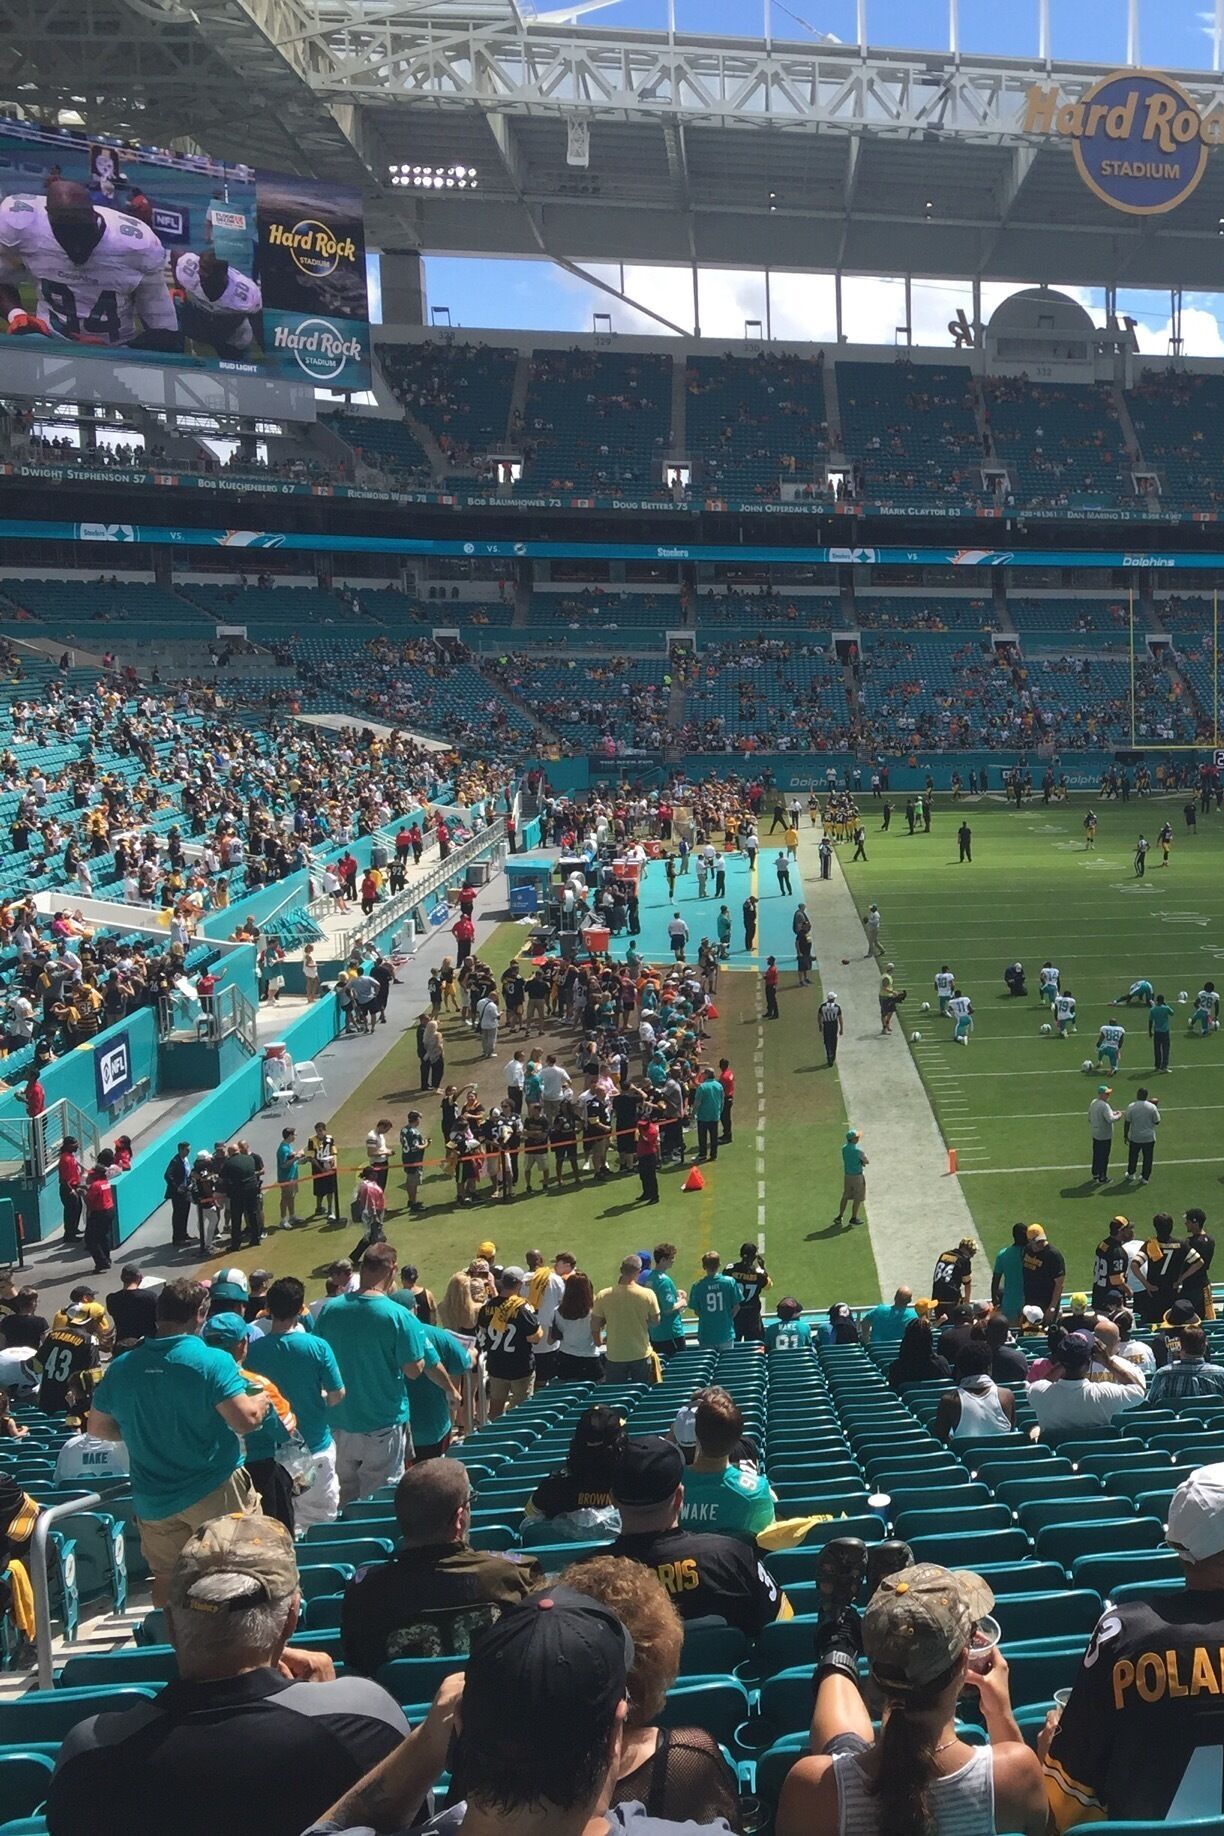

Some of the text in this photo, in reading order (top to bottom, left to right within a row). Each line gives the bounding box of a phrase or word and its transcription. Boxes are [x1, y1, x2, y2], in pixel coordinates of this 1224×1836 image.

[1023, 83, 1139, 139] Hard
[1102, 160, 1180, 179] STADIUM
[157, 215, 178, 228] NFL
[269, 224, 355, 261] Hard Rock
[300, 257, 330, 267] STADIUM
[274, 327, 361, 360] Hard Rock
[219, 361, 257, 372] BUD LIGHT
[305, 356, 336, 367] STADIUM
[21, 466, 146, 484] DWIGHT STEPHENSON 57
[198, 478, 295, 494] BOB KUECHENBERG 67
[467, 497, 561, 507] BOB BAUMHOWER 73
[613, 500, 638, 510] DOUG
[641, 501, 673, 511] BETTERS
[739, 504, 823, 514] JOHN OFFERDAHL 56
[880, 507, 960, 516] MARK CLAYTON 83
[1067, 510, 1085, 519] DAN
[1087, 511, 1118, 520] MARINO
[1120, 511, 1130, 520] 13
[1123, 556, 1175, 567] Dolphins
[956, 1001, 965, 1012] 11
[1058, 1000, 1069, 1012] 19
[1200, 996, 1213, 1008] 26
[1105, 1029, 1119, 1041] 88
[111, 1056, 125, 1076] NFL
[1160, 1249, 1174, 1275] 7
[706, 1292, 723, 1312] 91
[488, 1324, 517, 1352] 92
[45, 1346, 72, 1382] 43
[82, 1452, 108, 1465] WAKE
[577, 1490, 612, 1505] BROWN
[680, 1503, 719, 1521] WAKE
[656, 1559, 699, 1593] RIS
